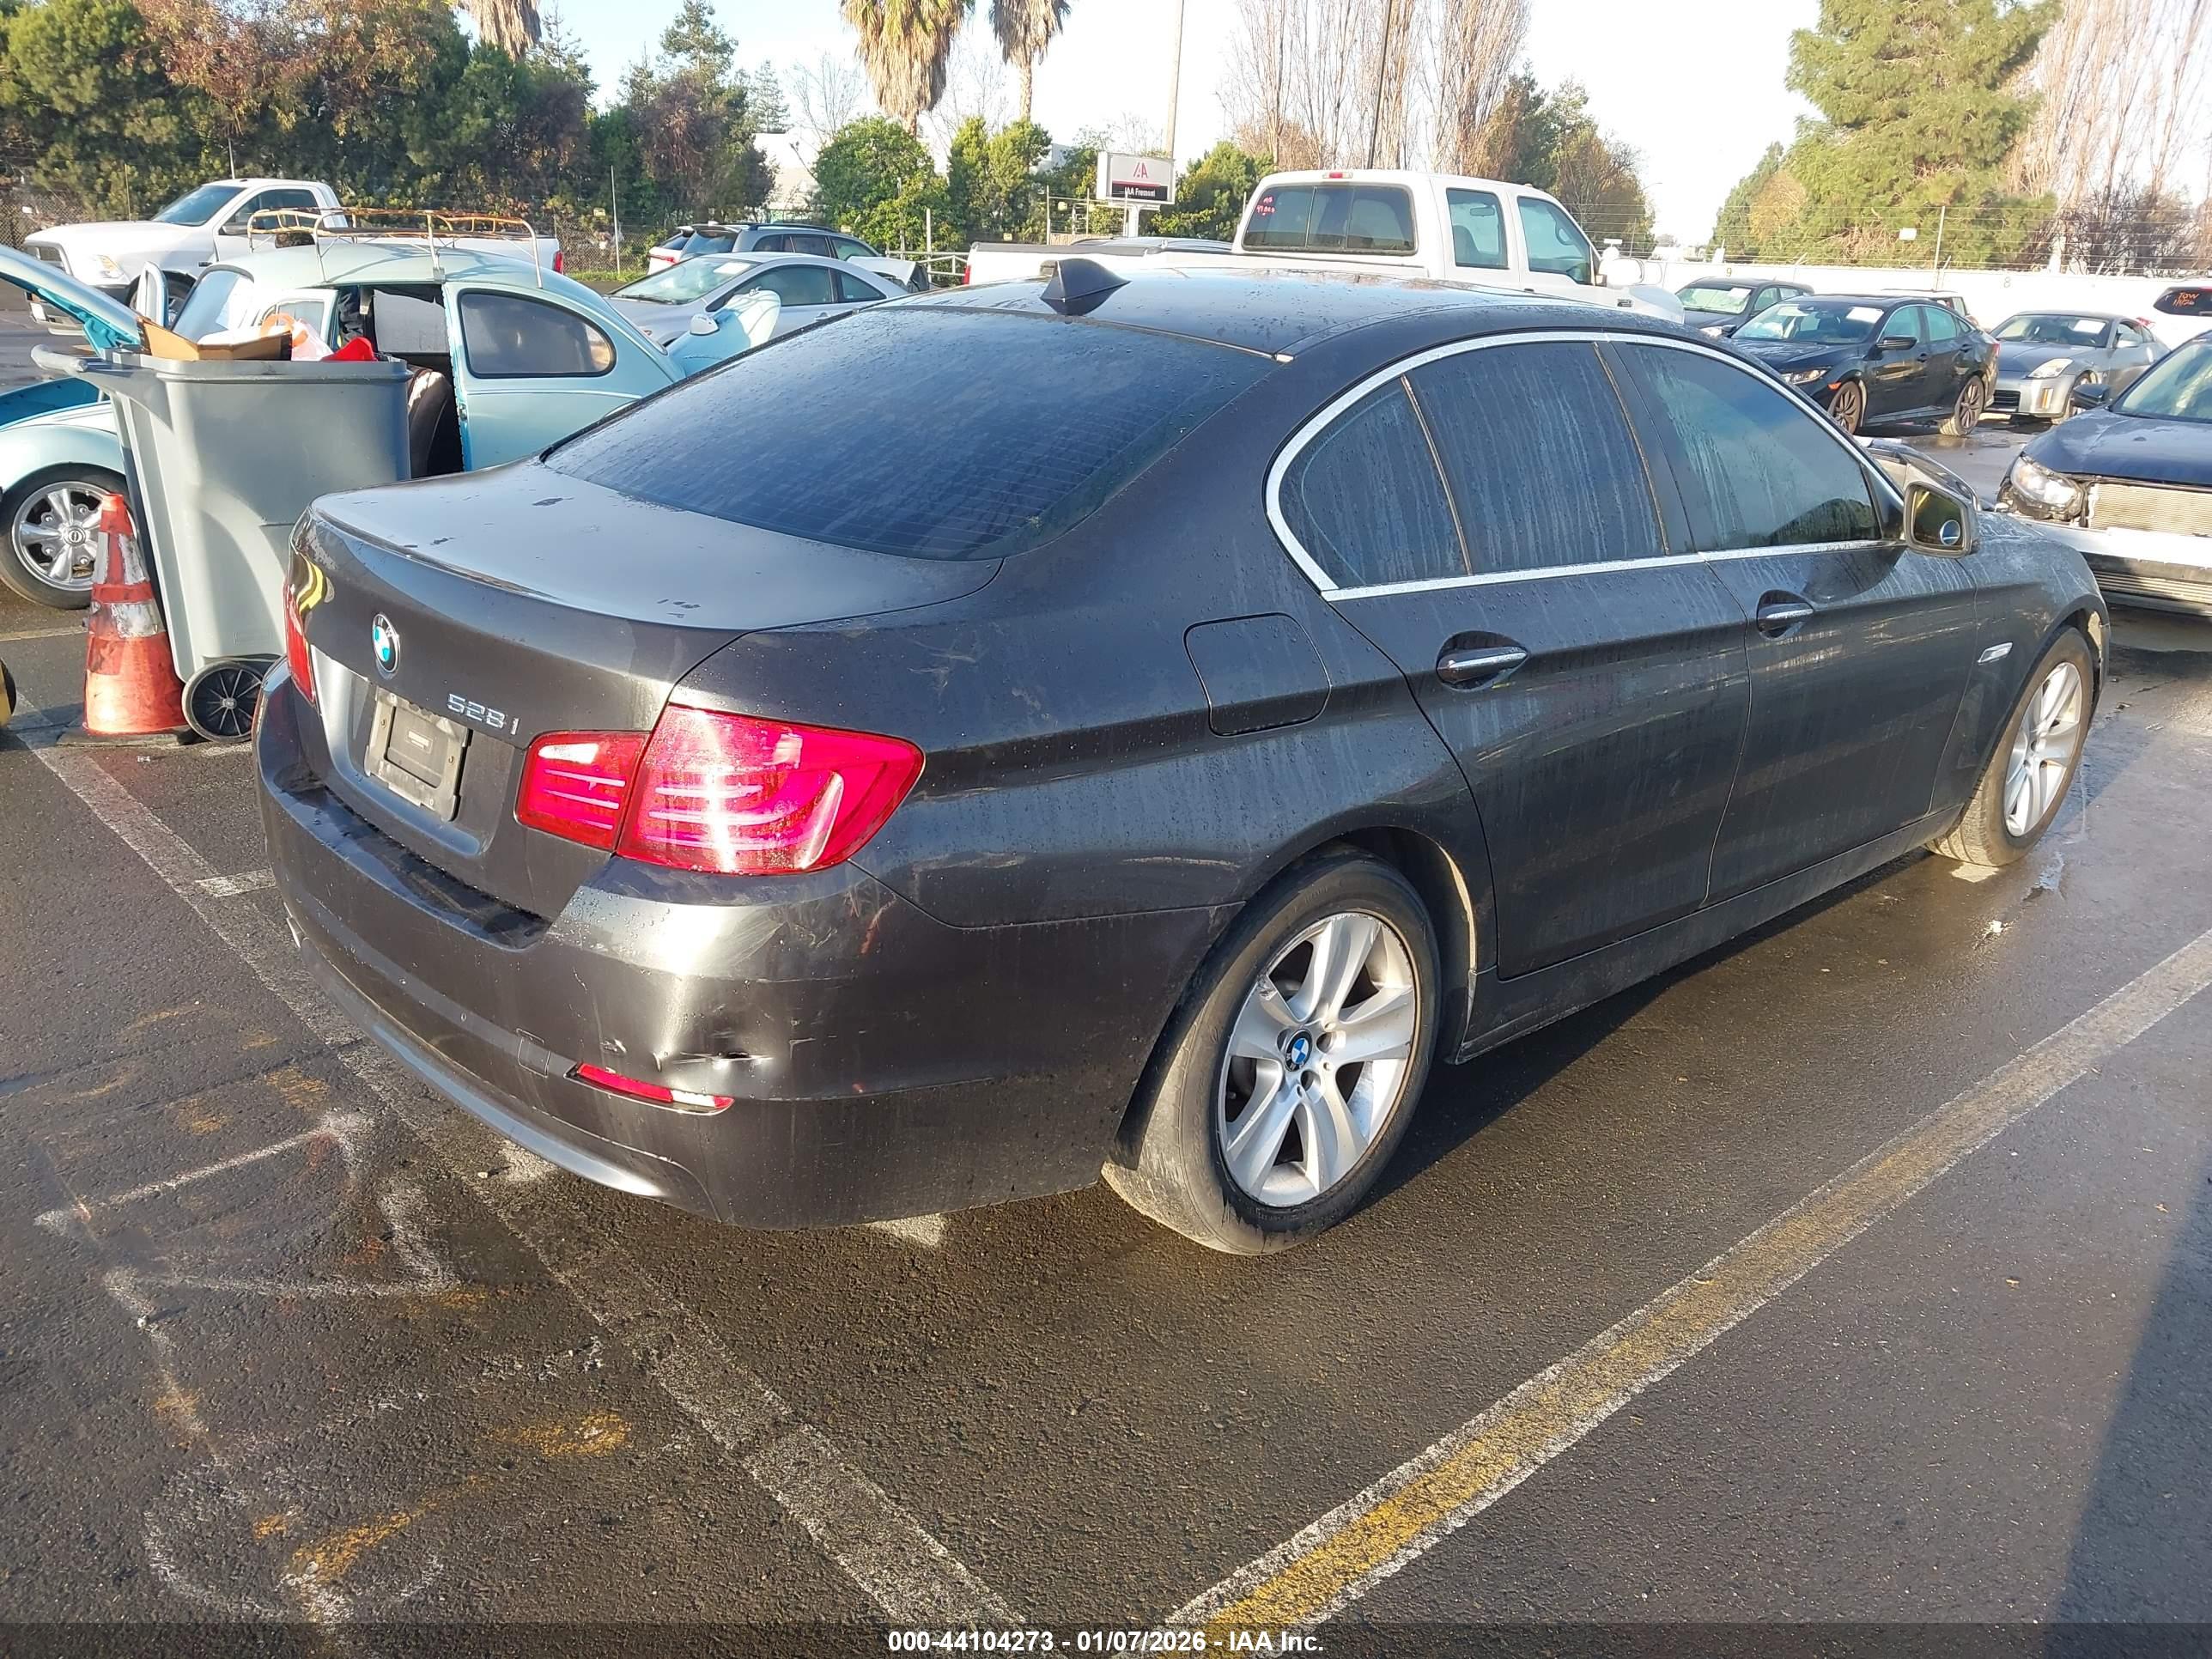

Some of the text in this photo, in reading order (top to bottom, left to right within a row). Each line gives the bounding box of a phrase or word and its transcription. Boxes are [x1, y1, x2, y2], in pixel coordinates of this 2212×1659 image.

[1135, 188, 1155, 198] Fremont
[1726, 267, 1732, 277] 9
[2003, 276, 2011, 289] 8
